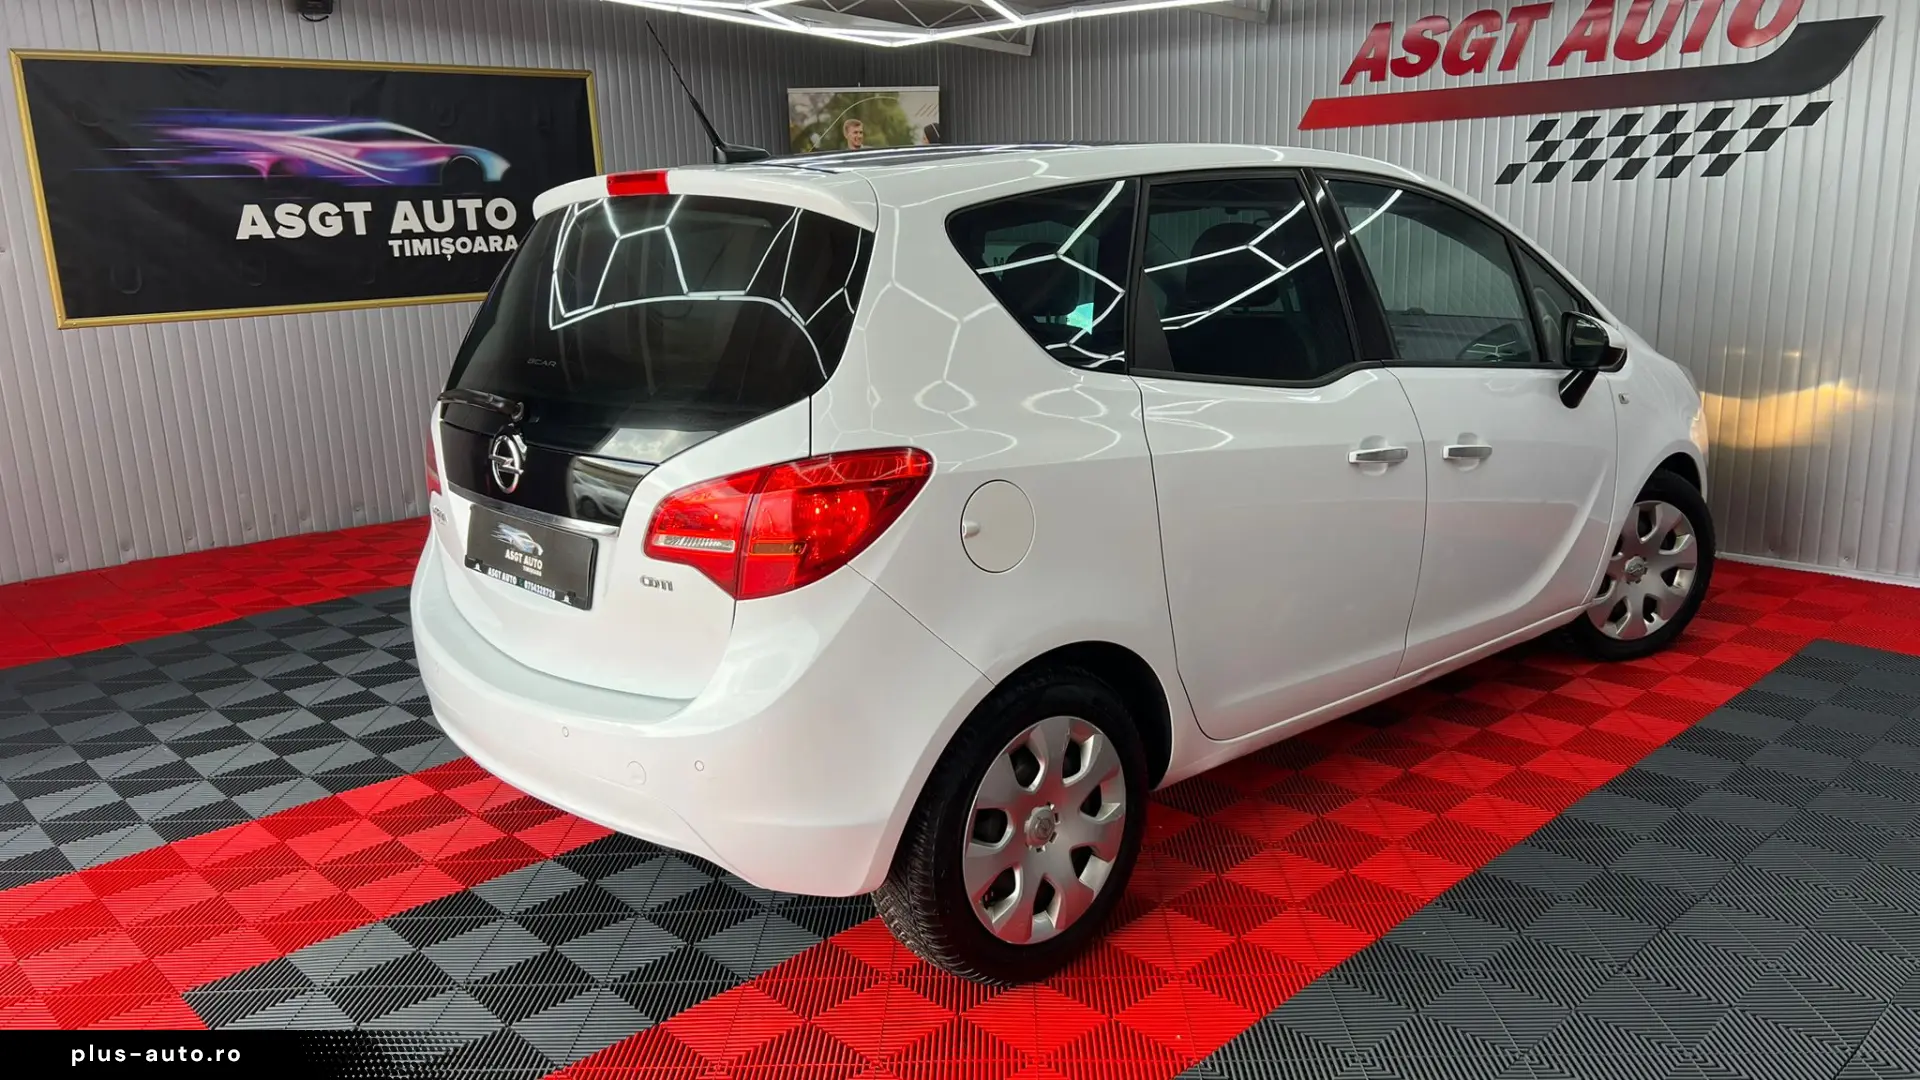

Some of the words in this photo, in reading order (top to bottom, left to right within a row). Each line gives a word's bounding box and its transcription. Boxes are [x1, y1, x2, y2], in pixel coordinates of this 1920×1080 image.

[1340, 2, 1551, 85] ASGT
[1547, 0, 1802, 67] AUTO
[236, 202, 372, 240] ASGT
[390, 198, 517, 234] AUTO
[388, 235, 518, 261] TIMIȘOARA
[504, 549, 523, 563] ASGT
[523, 555, 543, 570] AUTO
[488, 567, 502, 580] ASGT
[502, 573, 517, 585] AUTO
